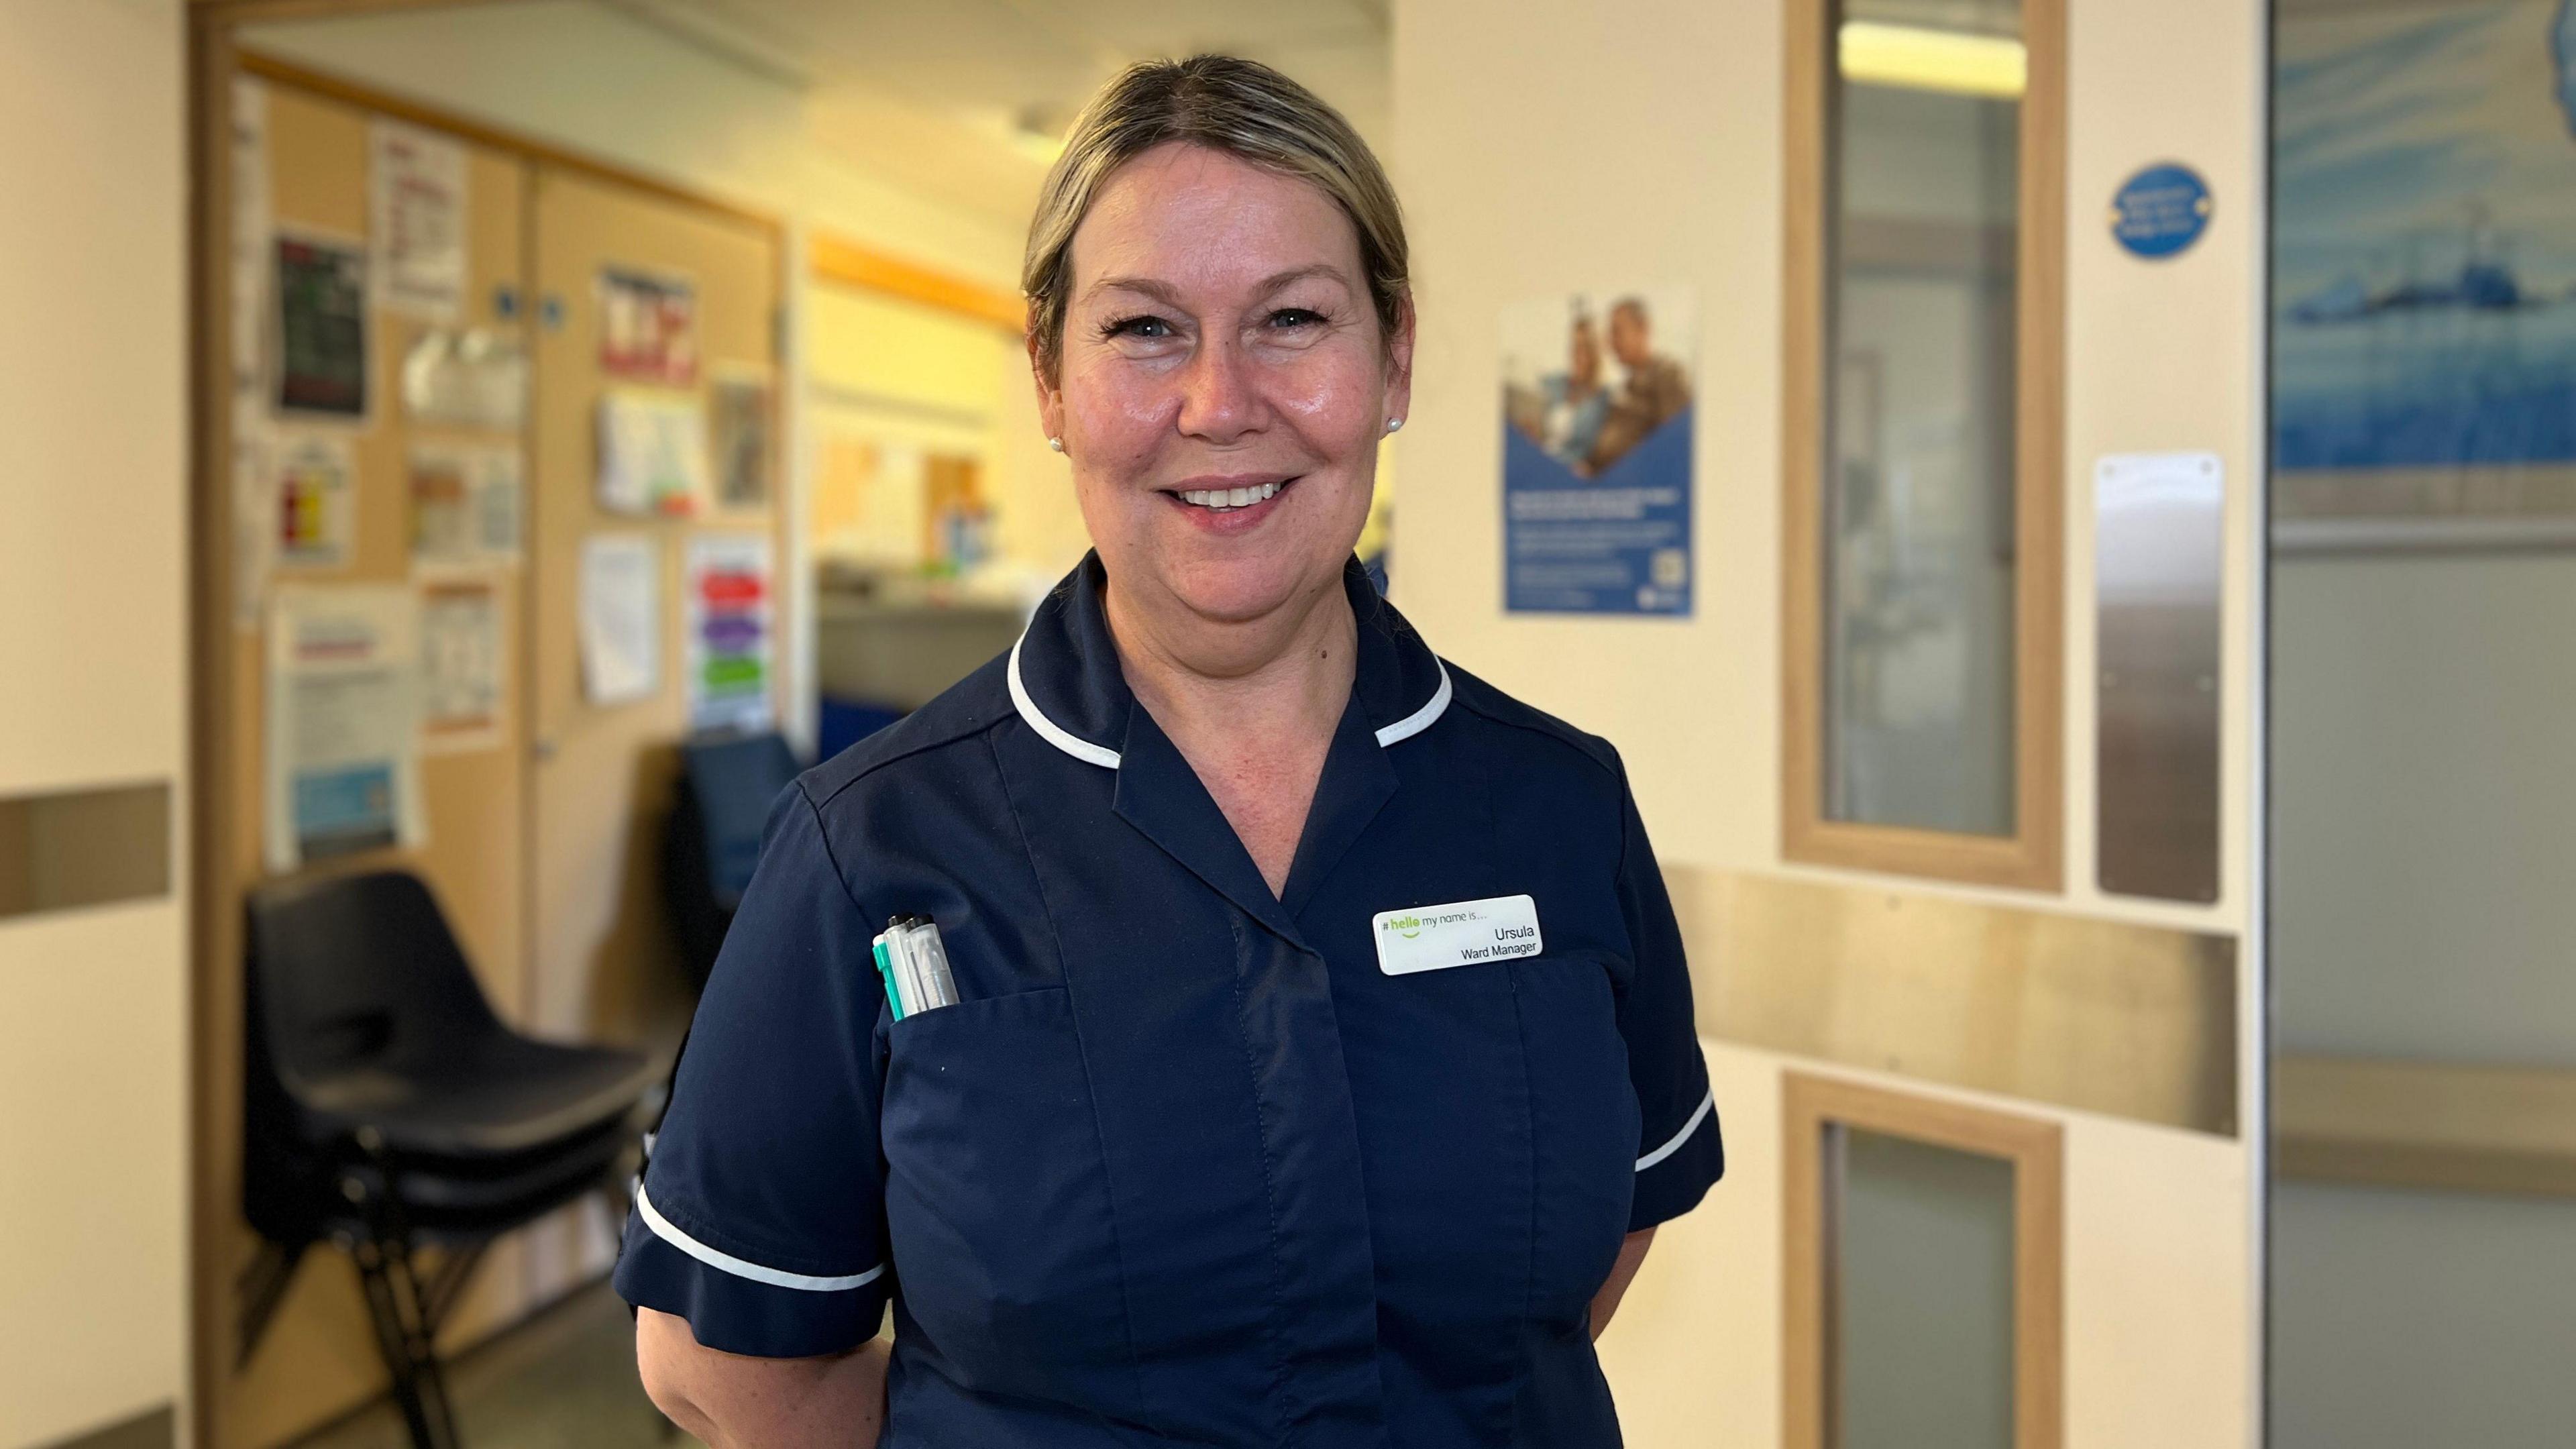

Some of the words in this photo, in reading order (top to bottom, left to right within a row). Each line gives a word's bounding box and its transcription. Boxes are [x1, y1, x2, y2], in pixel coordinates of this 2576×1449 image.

[1422, 916, 1438, 928] my
[1439, 912, 1466, 924] name
[1495, 926, 1534, 940] Ursula
[1461, 947, 1489, 960] Ward
[1491, 943, 1537, 956] Manager
